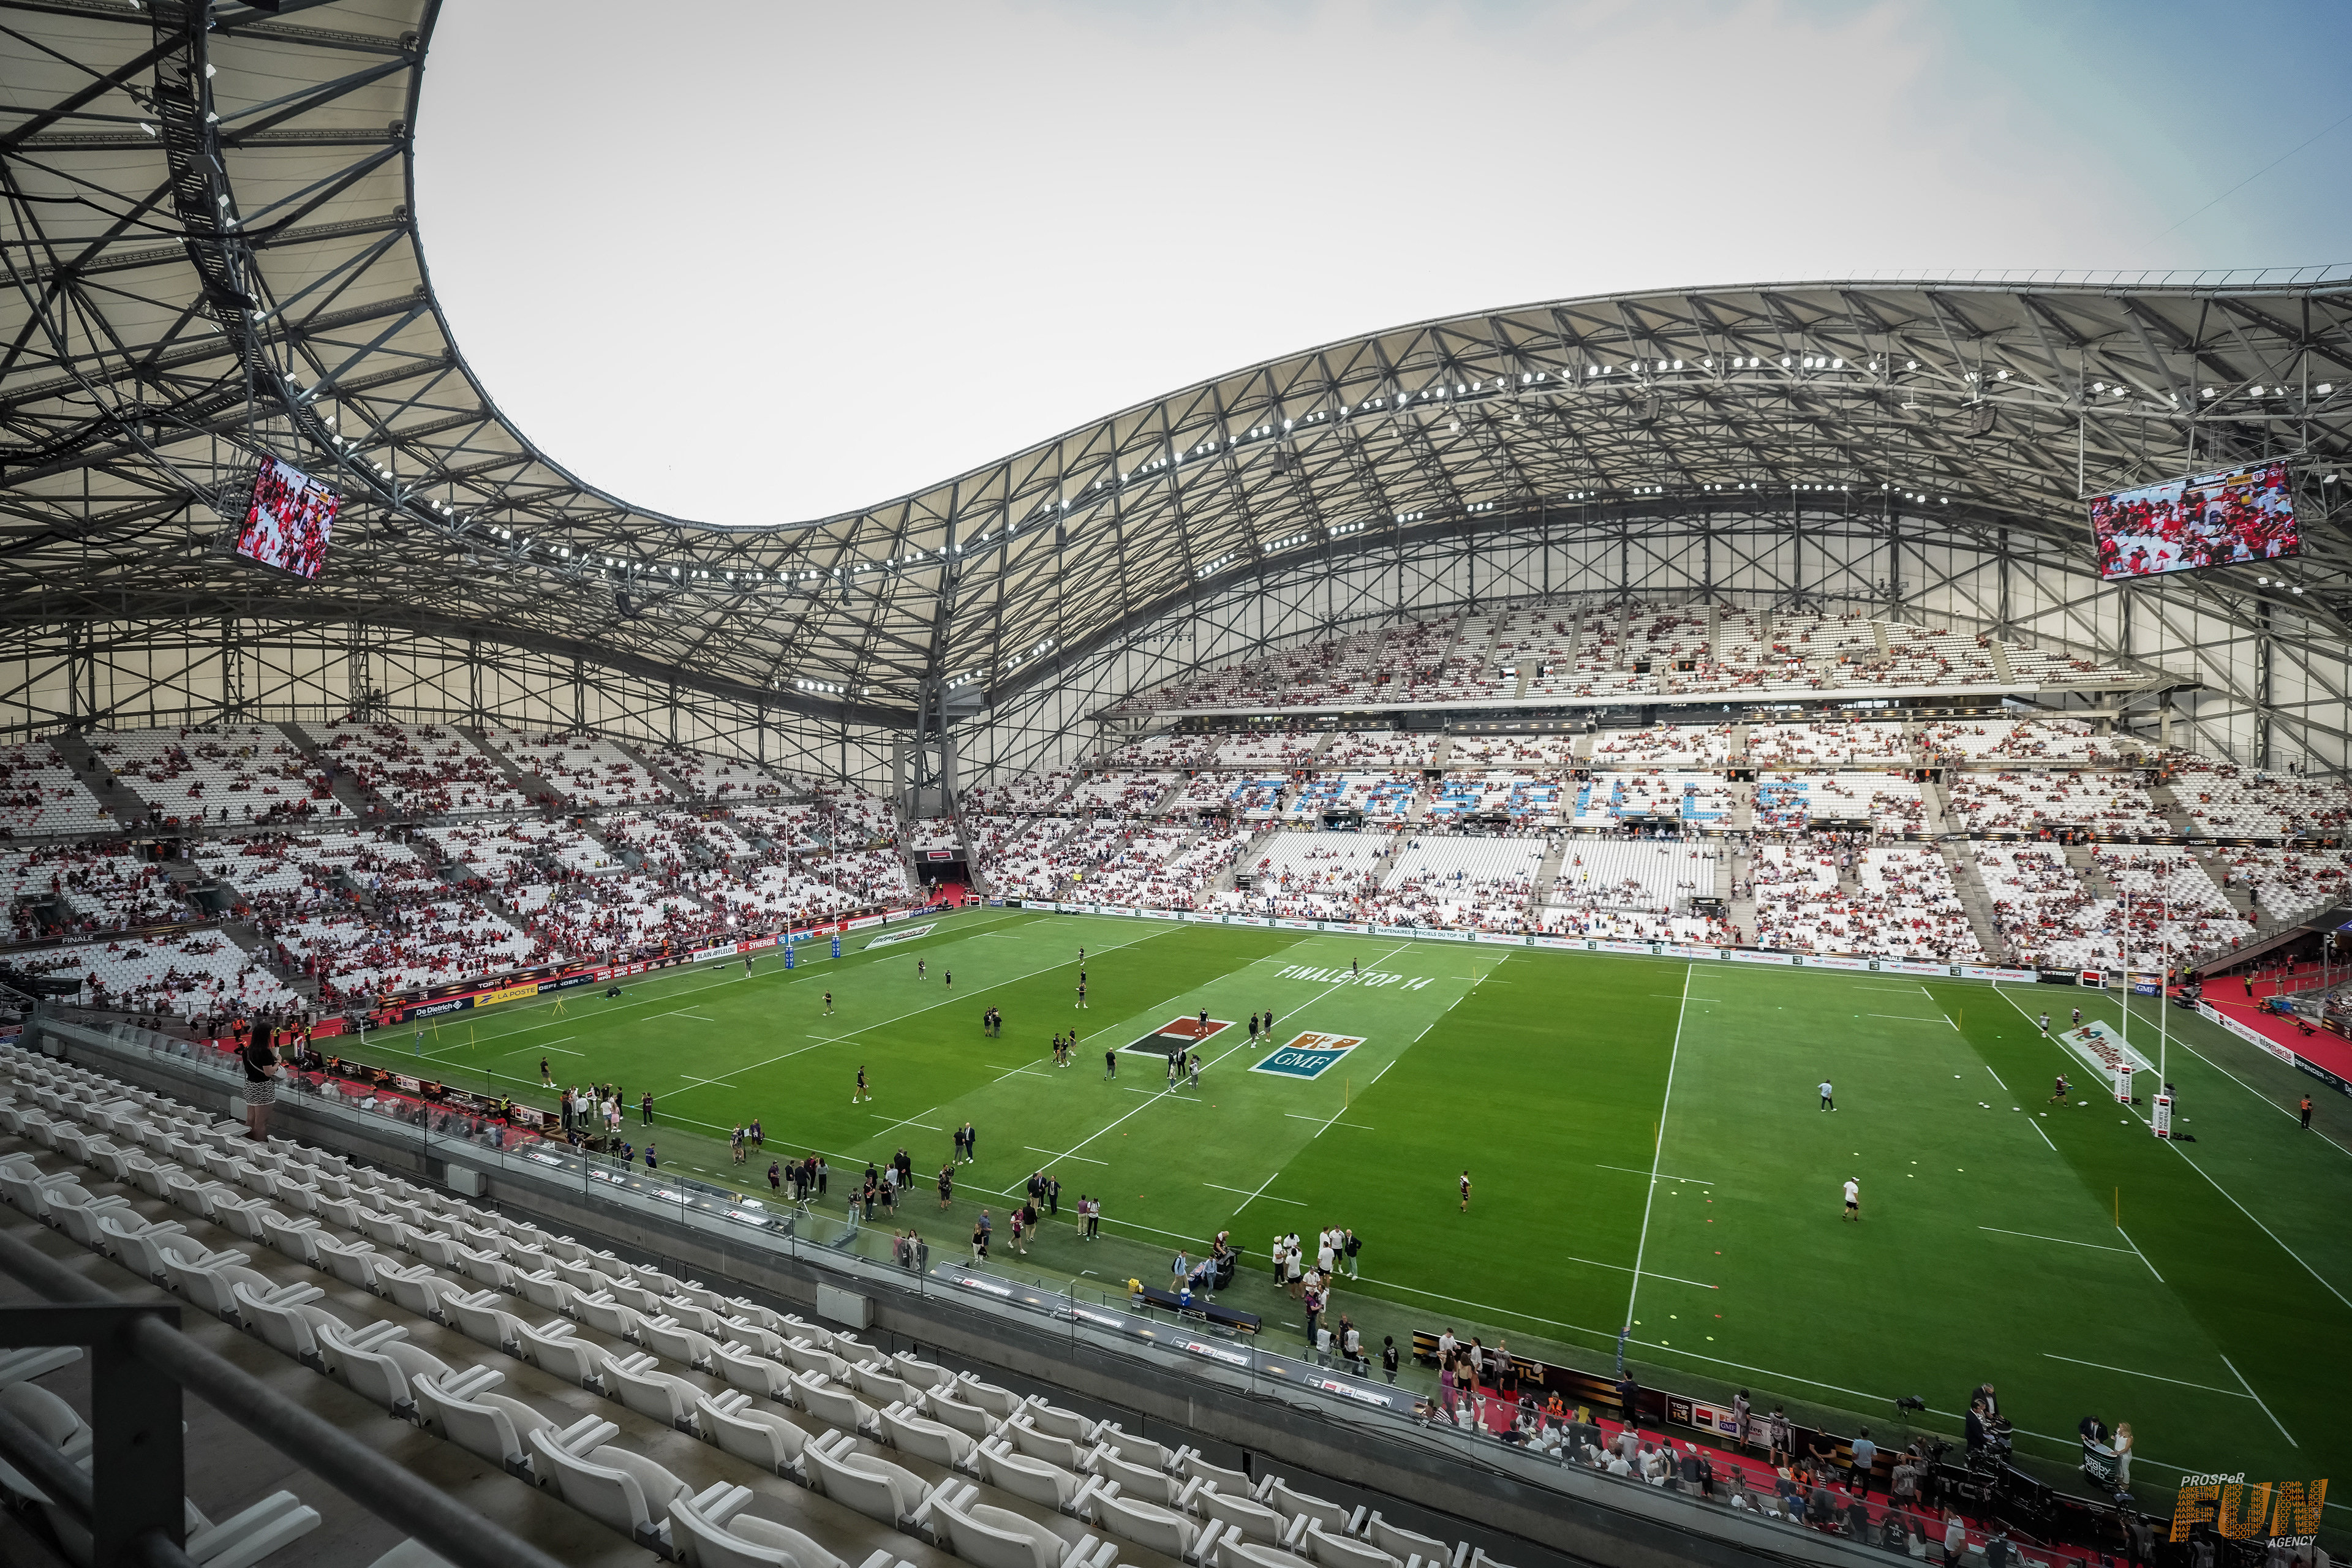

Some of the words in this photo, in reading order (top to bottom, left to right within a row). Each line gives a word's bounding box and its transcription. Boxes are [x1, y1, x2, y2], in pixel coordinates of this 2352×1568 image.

[62, 935, 94, 944] FINALE
[748, 938, 776, 950] SYNERGIE
[696, 951, 712, 960] ALAIN
[712, 946, 735, 957] AFFLELOU
[1273, 965, 1354, 983] FINALE
[1352, 972, 1403, 987] TOP
[1400, 976, 1435, 990] 14
[510, 987, 536, 997] POSTE
[427, 1003, 453, 1014] Dietrich
[2233, 1023, 2256, 1042] TotalEnergies
[2259, 1036, 2292, 1061] Intermarché
[1274, 1052, 1330, 1069] GMF
[2295, 1058, 2324, 1079] DEFENDER
[1390, 1354, 1395, 1363] 7
[1670, 1401, 1689, 1410] TOP
[1672, 1411, 1688, 1422] 14
[1720, 1422, 1737, 1432] GMF
[2084, 1453, 2111, 1476] Rugby
[2086, 1462, 2105, 1479] Club
